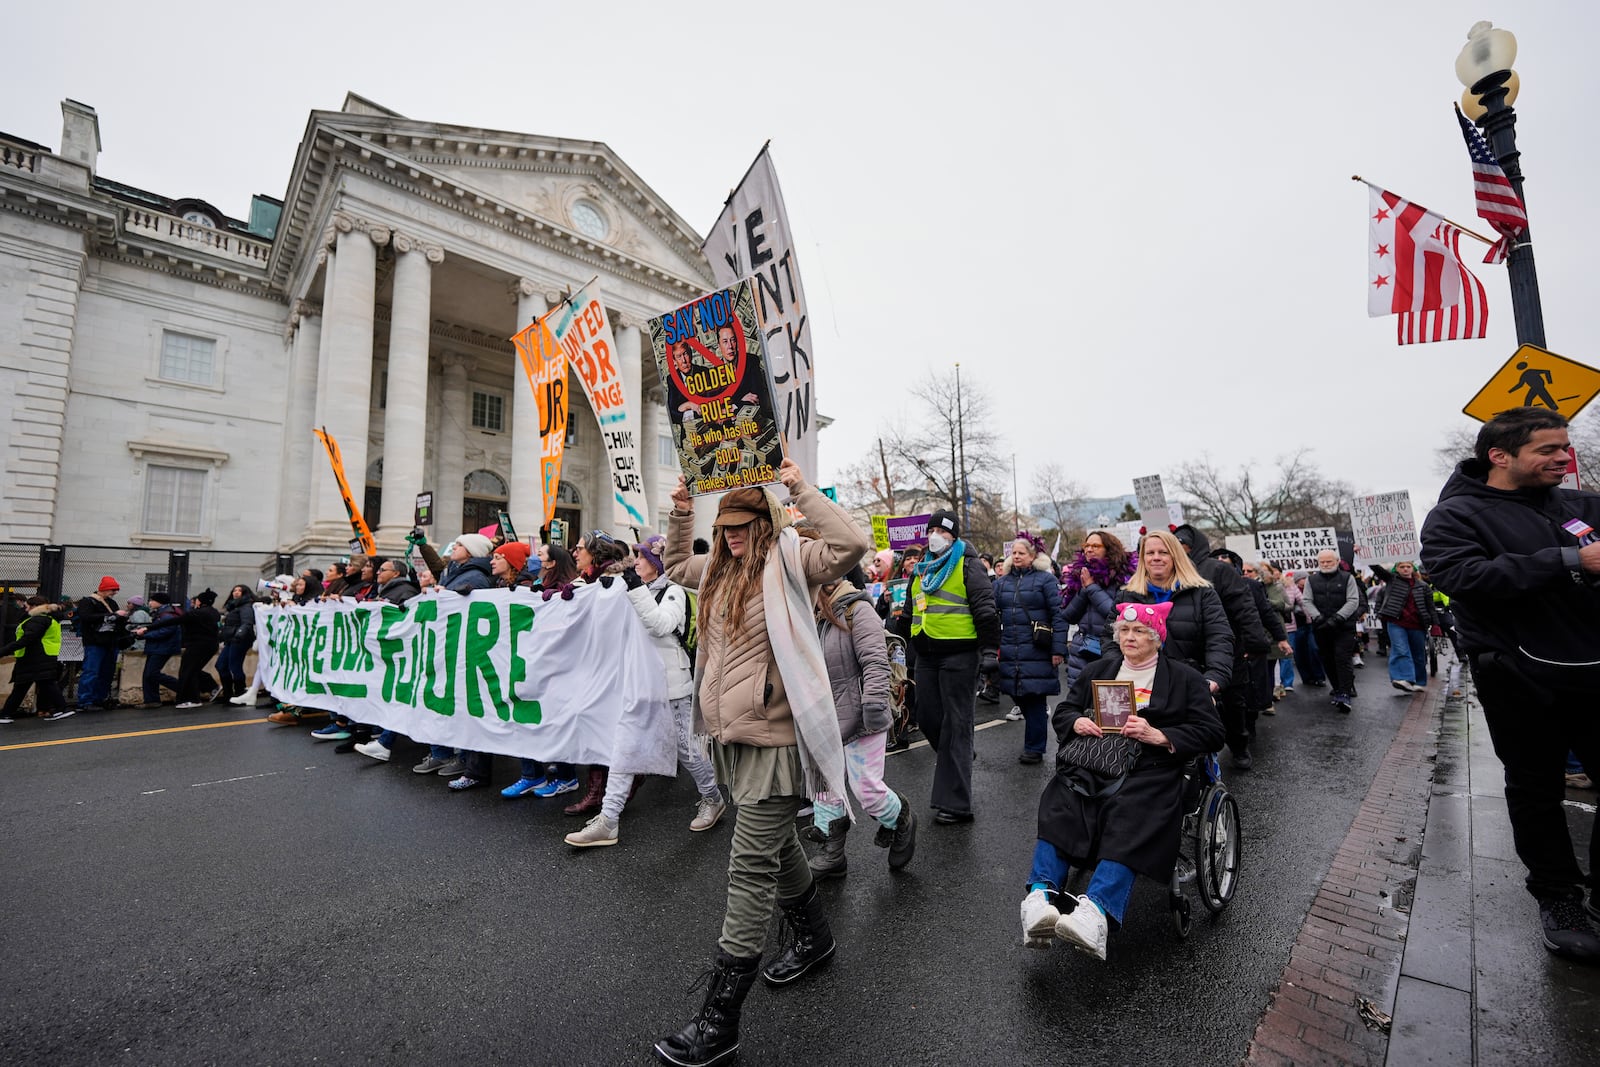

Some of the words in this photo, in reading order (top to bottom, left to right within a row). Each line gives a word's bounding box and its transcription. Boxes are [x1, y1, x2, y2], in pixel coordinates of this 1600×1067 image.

[663, 305, 696, 345] SAY
[698, 289, 734, 333] NO!
[686, 362, 736, 395] GOLDEN
[701, 397, 734, 423] RULE
[690, 432, 702, 447] He
[703, 428, 722, 444] who
[723, 424, 740, 440] has
[742, 419, 758, 435] the
[715, 447, 739, 465] GOLD
[697, 475, 725, 491] makes
[726, 472, 741, 486] the
[742, 464, 773, 483] RULES
[1351, 497, 1363, 507] IF
[1365, 496, 1375, 506] MY
[1376, 491, 1409, 505] ABORTION
[1354, 507, 1365, 517] IS
[1368, 503, 1393, 516] GOING
[1397, 501, 1407, 511] TO
[1361, 513, 1379, 527] GET
[1397, 512, 1405, 522] A
[888, 523, 928, 534] REPRODUCTIV
[1261, 531, 1299, 540] WHEN
[1321, 529, 1331, 537] I
[890, 533, 915, 542] FREEDOM
[1264, 541, 1284, 550] GET
[1287, 540, 1300, 549] TO
[1303, 538, 1335, 547] MAKE
[1261, 549, 1308, 559] DECISIONS
[1374, 545, 1384, 558] MY
[1386, 542, 1417, 556] RAPIST
[1303, 558, 1320, 570] BOD
[331, 608, 374, 673] OUR
[377, 599, 542, 725] FUTURE
